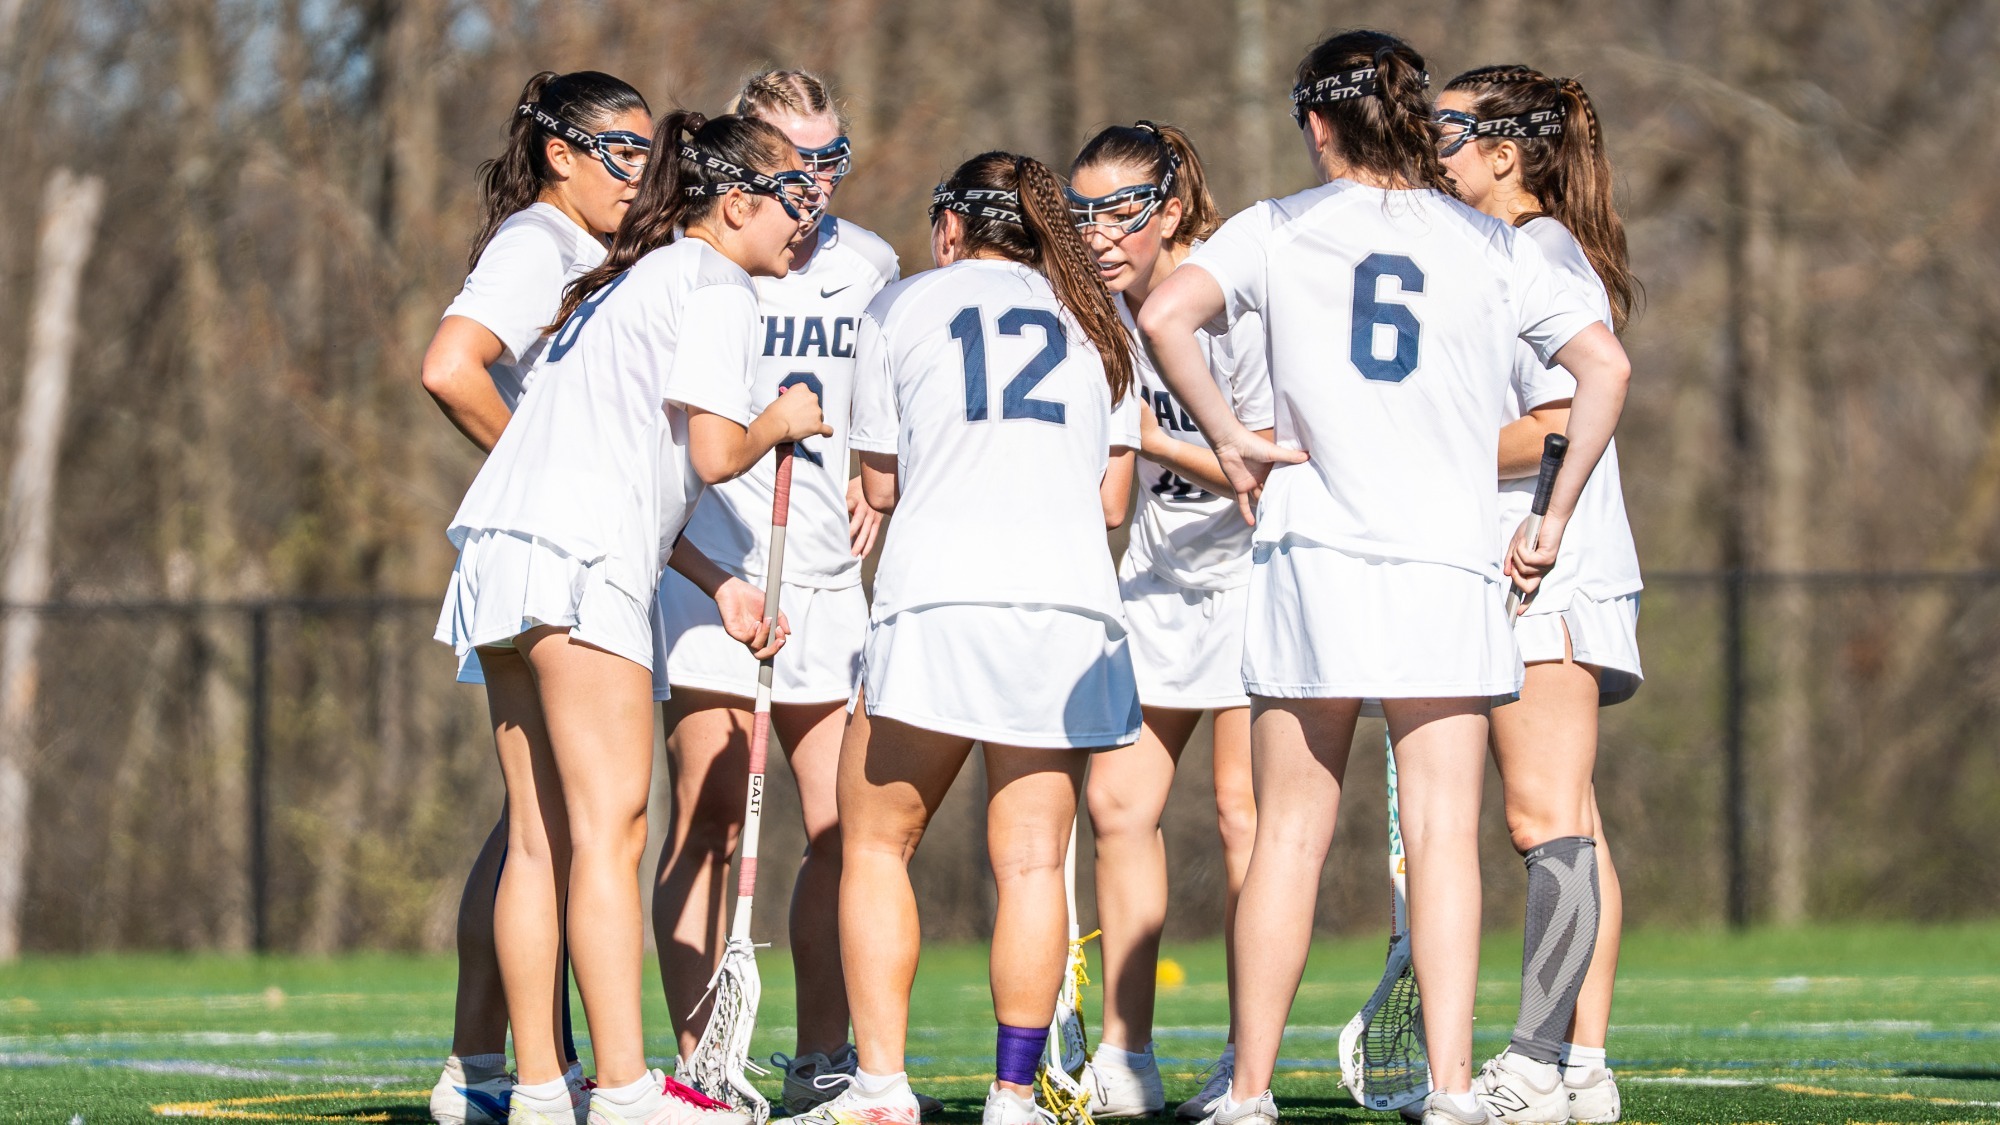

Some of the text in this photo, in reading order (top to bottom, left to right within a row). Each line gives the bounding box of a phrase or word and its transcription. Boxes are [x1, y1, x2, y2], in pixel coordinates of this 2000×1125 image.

[1315, 75, 1342, 92] STX
[1351, 68, 1378, 82] ST
[1330, 85, 1362, 100] STX
[536, 110, 597, 147] STX STX
[1478, 117, 1519, 133] STX
[706, 157, 744, 177] STX
[753, 174, 780, 188] ST
[1160, 169, 1173, 194] STX
[685, 185, 705, 197] TX
[934, 189, 1016, 204] STX STX
[981, 206, 1022, 223] STX
[1348, 250, 1427, 385] 6
[761, 316, 862, 358] HAC
[948, 305, 1068, 425] 12
[750, 775, 762, 816] GAIT
